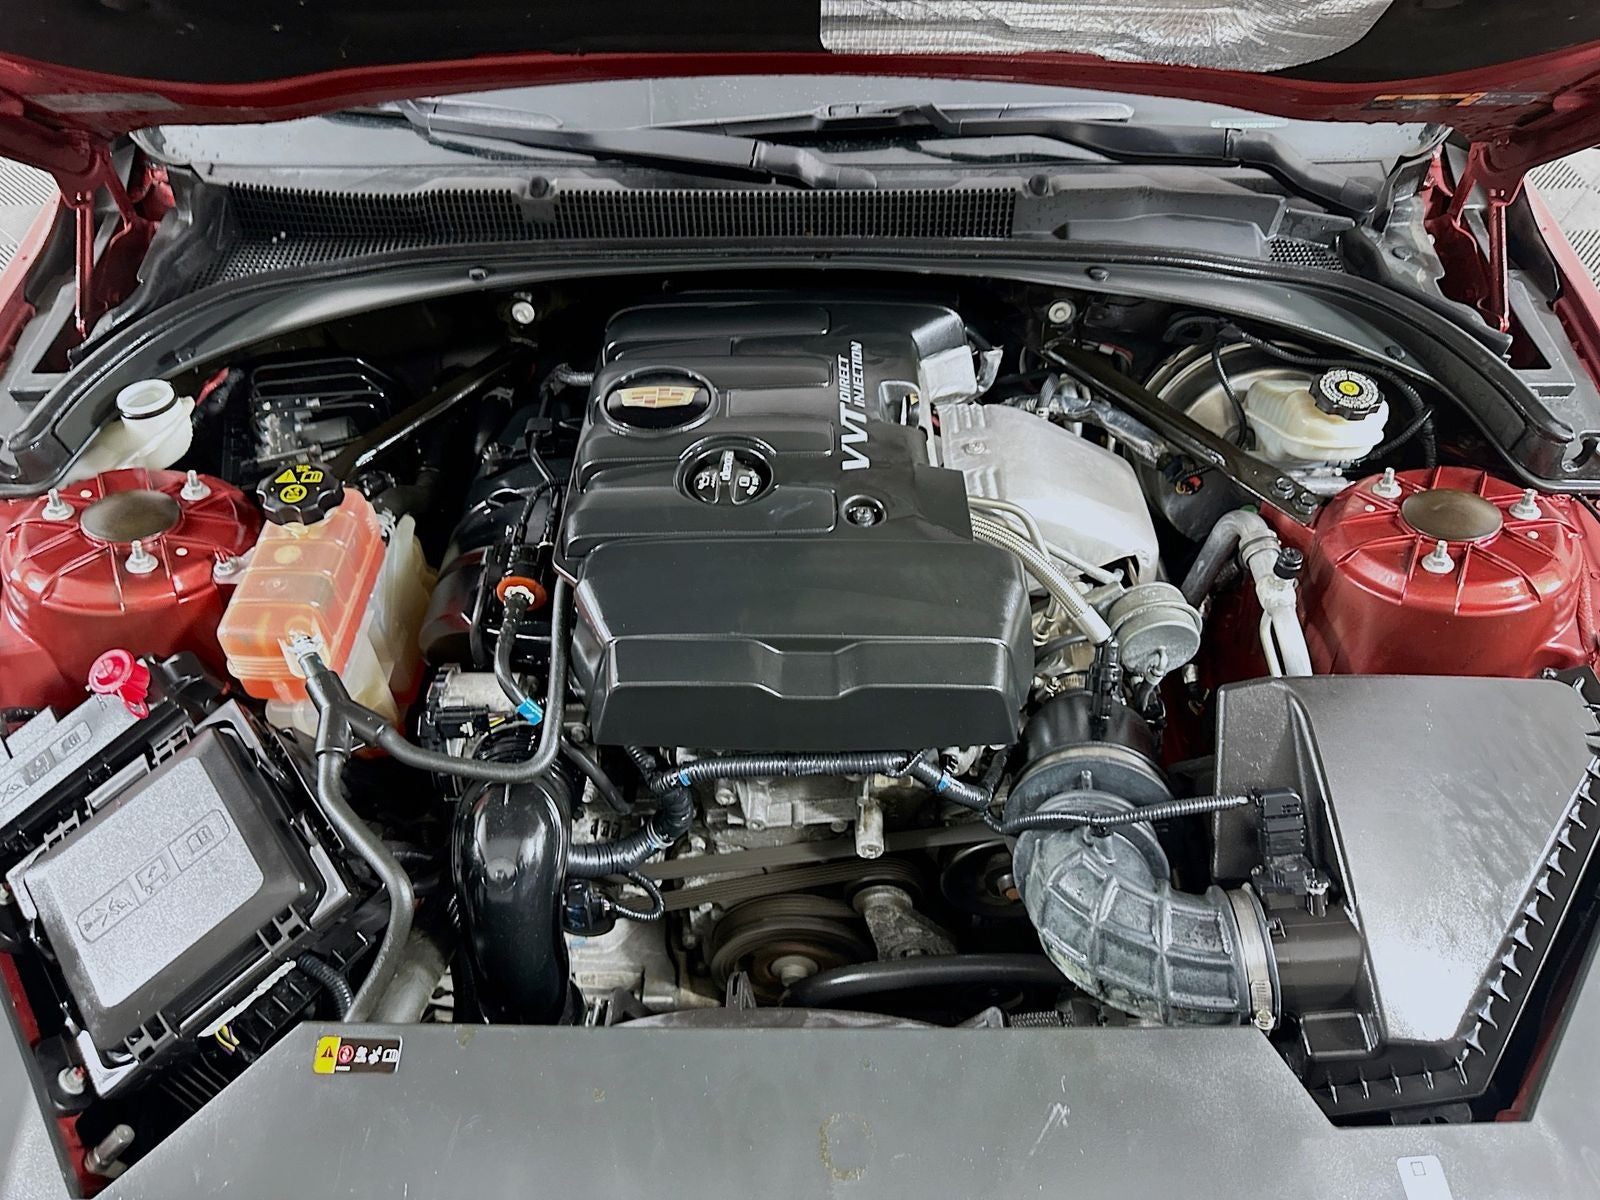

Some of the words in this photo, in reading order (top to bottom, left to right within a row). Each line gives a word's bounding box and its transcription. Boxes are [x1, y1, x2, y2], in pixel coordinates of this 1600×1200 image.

[838, 354, 851, 403] DIRECT
[851, 341, 865, 408] INJECTION
[840, 402, 870, 470] VVT
